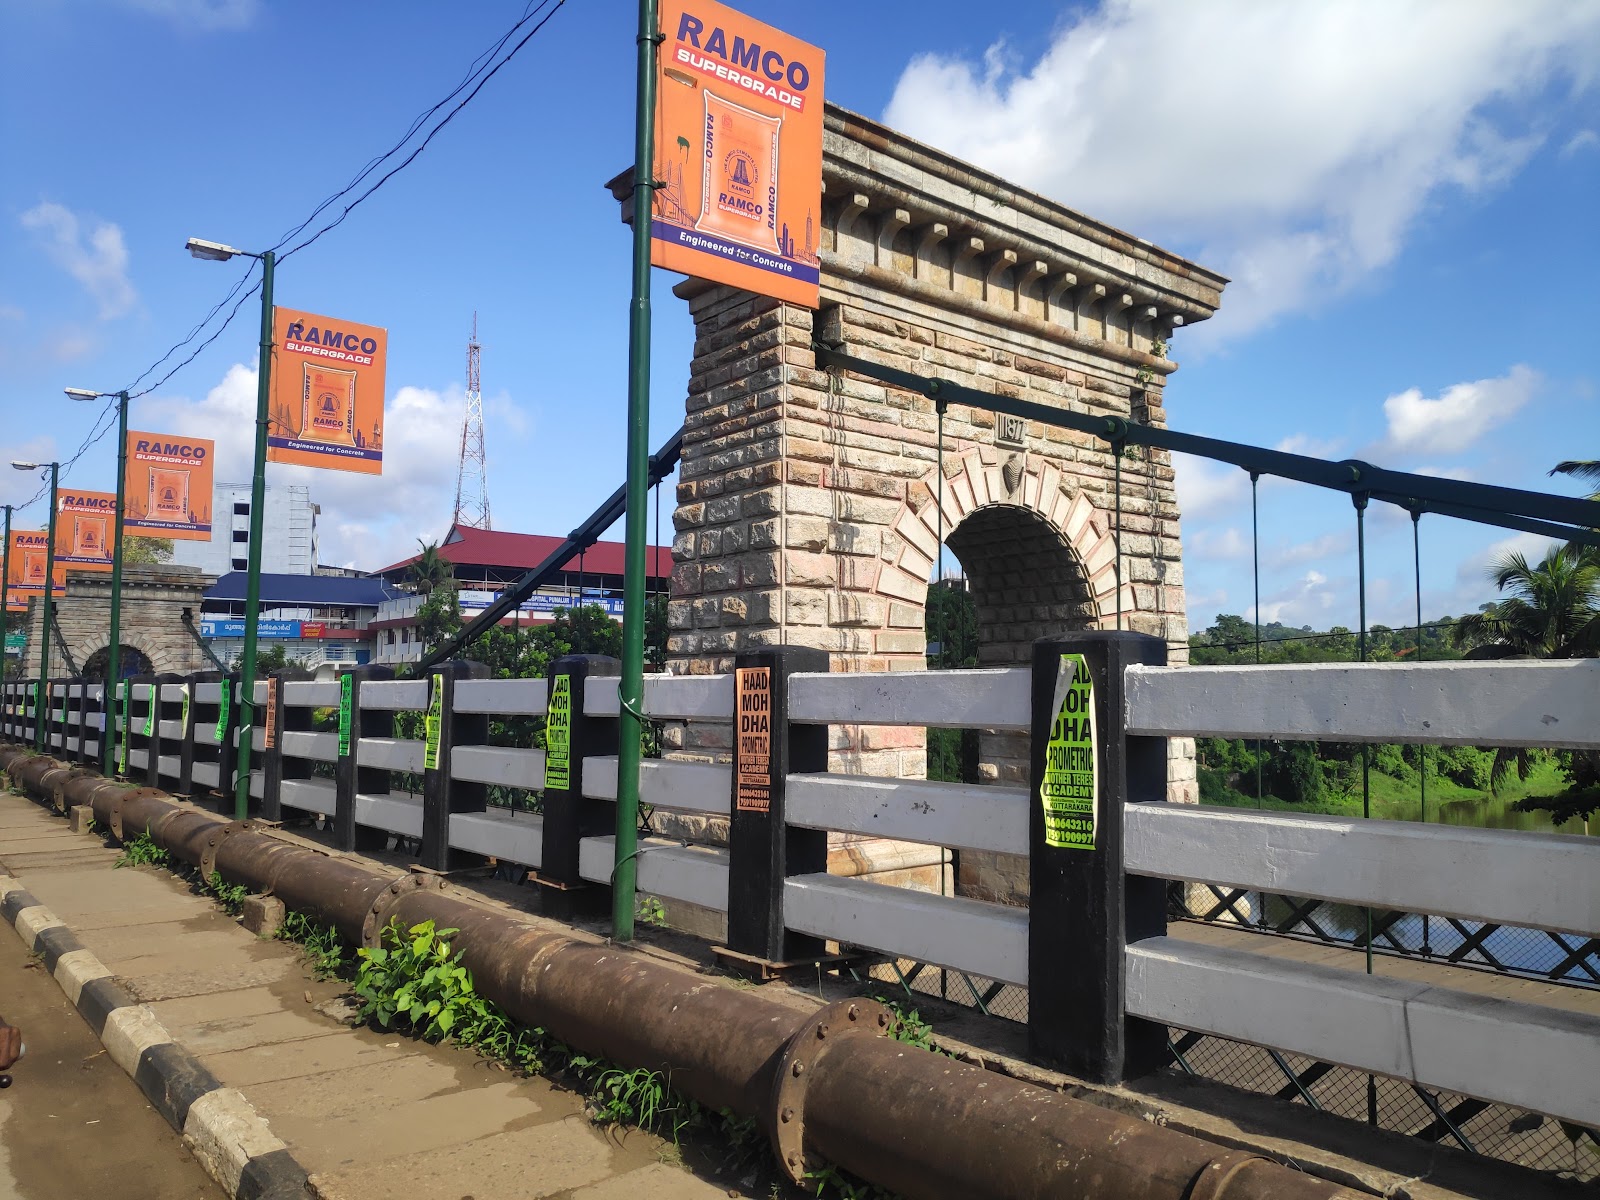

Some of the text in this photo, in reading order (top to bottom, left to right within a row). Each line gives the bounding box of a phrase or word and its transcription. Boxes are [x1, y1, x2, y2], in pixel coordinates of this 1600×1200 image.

[677, 12, 809, 91] RAMCO
[677, 49, 802, 109] SUPERGRADE
[706, 113, 714, 158] RAMCO
[731, 184, 750, 194] RAMCO
[719, 192, 763, 215] RAMCO
[768, 186, 776, 230] RAMCO
[719, 205, 760, 221] SUPERGRADE
[680, 232, 792, 272] Engineered for Concrete
[286, 322, 377, 354] RAMCO
[286, 343, 371, 364] SUPERGRADE
[314, 417, 344, 426] RAMCO
[136, 440, 206, 458] RAMCO
[288, 441, 324, 451] Engineered
[336, 448, 364, 456] Concrete
[136, 454, 201, 465] SUPERGRADE
[65, 496, 116, 508] RAMCO
[65, 506, 115, 514] SUPERGRADE
[1072, 660, 1092, 684] AD
[554, 679, 568, 693] AAD
[744, 672, 768, 690] HAAD
[552, 696, 568, 709] MOH
[742, 694, 768, 711] MOH
[1060, 689, 1090, 713] OH
[550, 713, 568, 726] DHA
[742, 715, 768, 732] DHA
[1050, 718, 1092, 741] DHA
[742, 736, 767, 754] PROMETRIC
[1049, 746, 1093, 771] PROMETRIC
[741, 764, 768, 773] ACADEMY
[1046, 784, 1094, 797] ACADEMY
[1050, 802, 1093, 811] KOTTARAKARA
